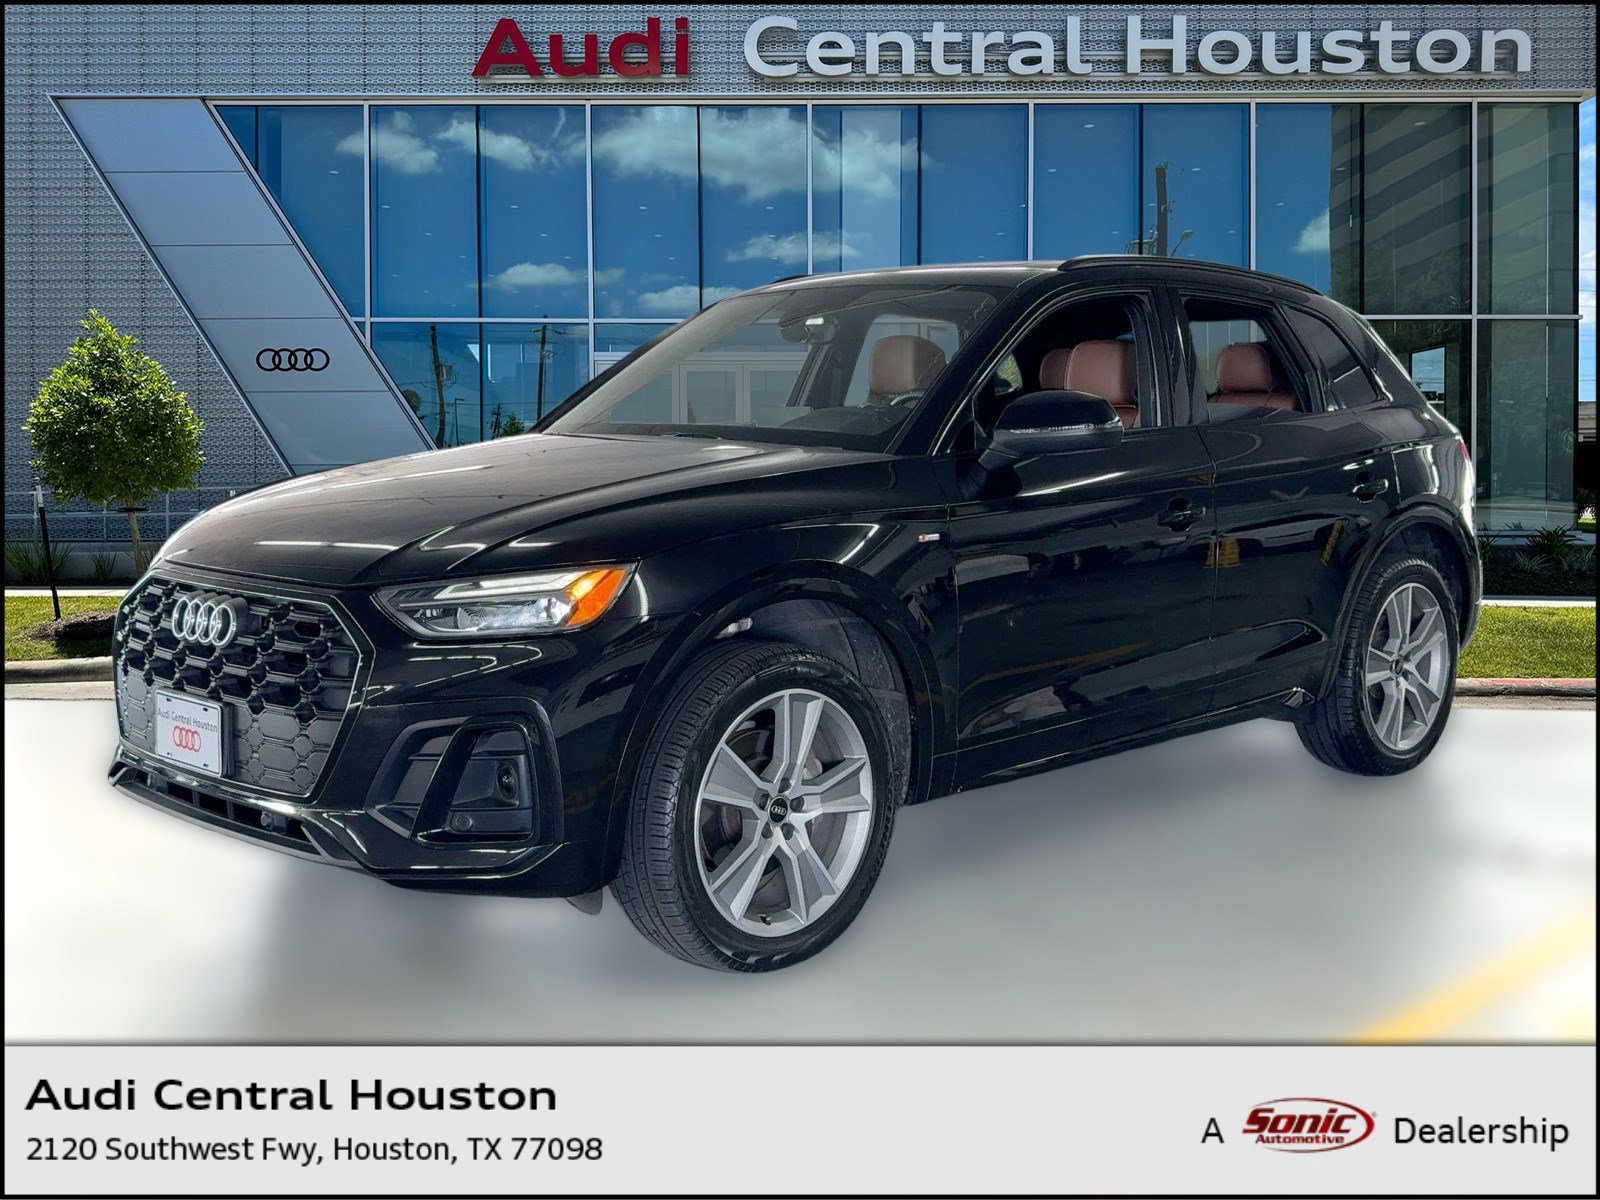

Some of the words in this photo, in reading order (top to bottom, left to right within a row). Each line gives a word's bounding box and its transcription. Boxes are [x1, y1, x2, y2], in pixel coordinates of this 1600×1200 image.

[472, 16, 690, 79] Audi
[743, 15, 1094, 78] Central
[1126, 15, 1533, 75] Houston
[157, 707, 170, 719] Audi
[171, 710, 193, 726] Central
[193, 716, 218, 733] Houston
